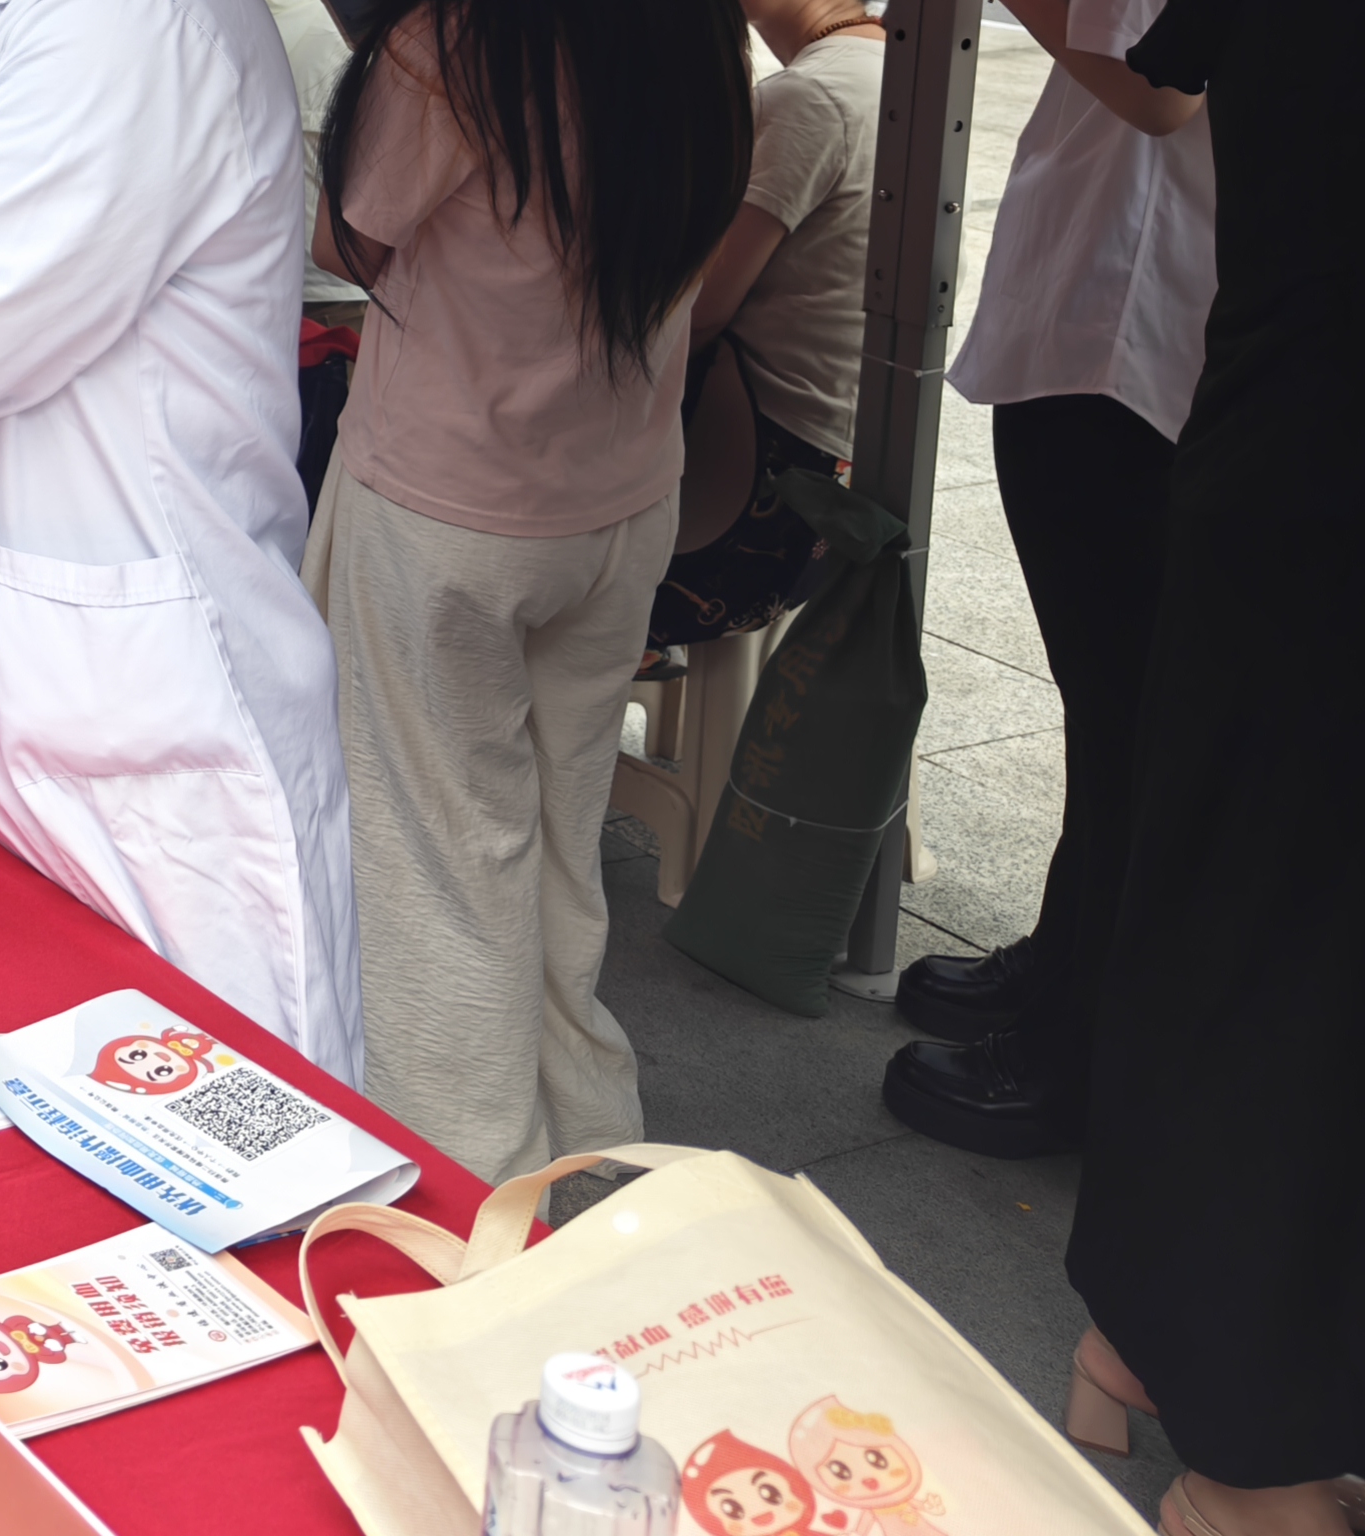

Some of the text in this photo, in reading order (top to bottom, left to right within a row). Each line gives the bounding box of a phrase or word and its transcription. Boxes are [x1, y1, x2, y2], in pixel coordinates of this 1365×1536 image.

[0, 1076, 206, 1218] 优先用血操作流程示意
[70, 1281, 159, 1354] 免费用血
[95, 1274, 186, 1347] 报销须知
[677, 1274, 794, 1329] 感谢有您
